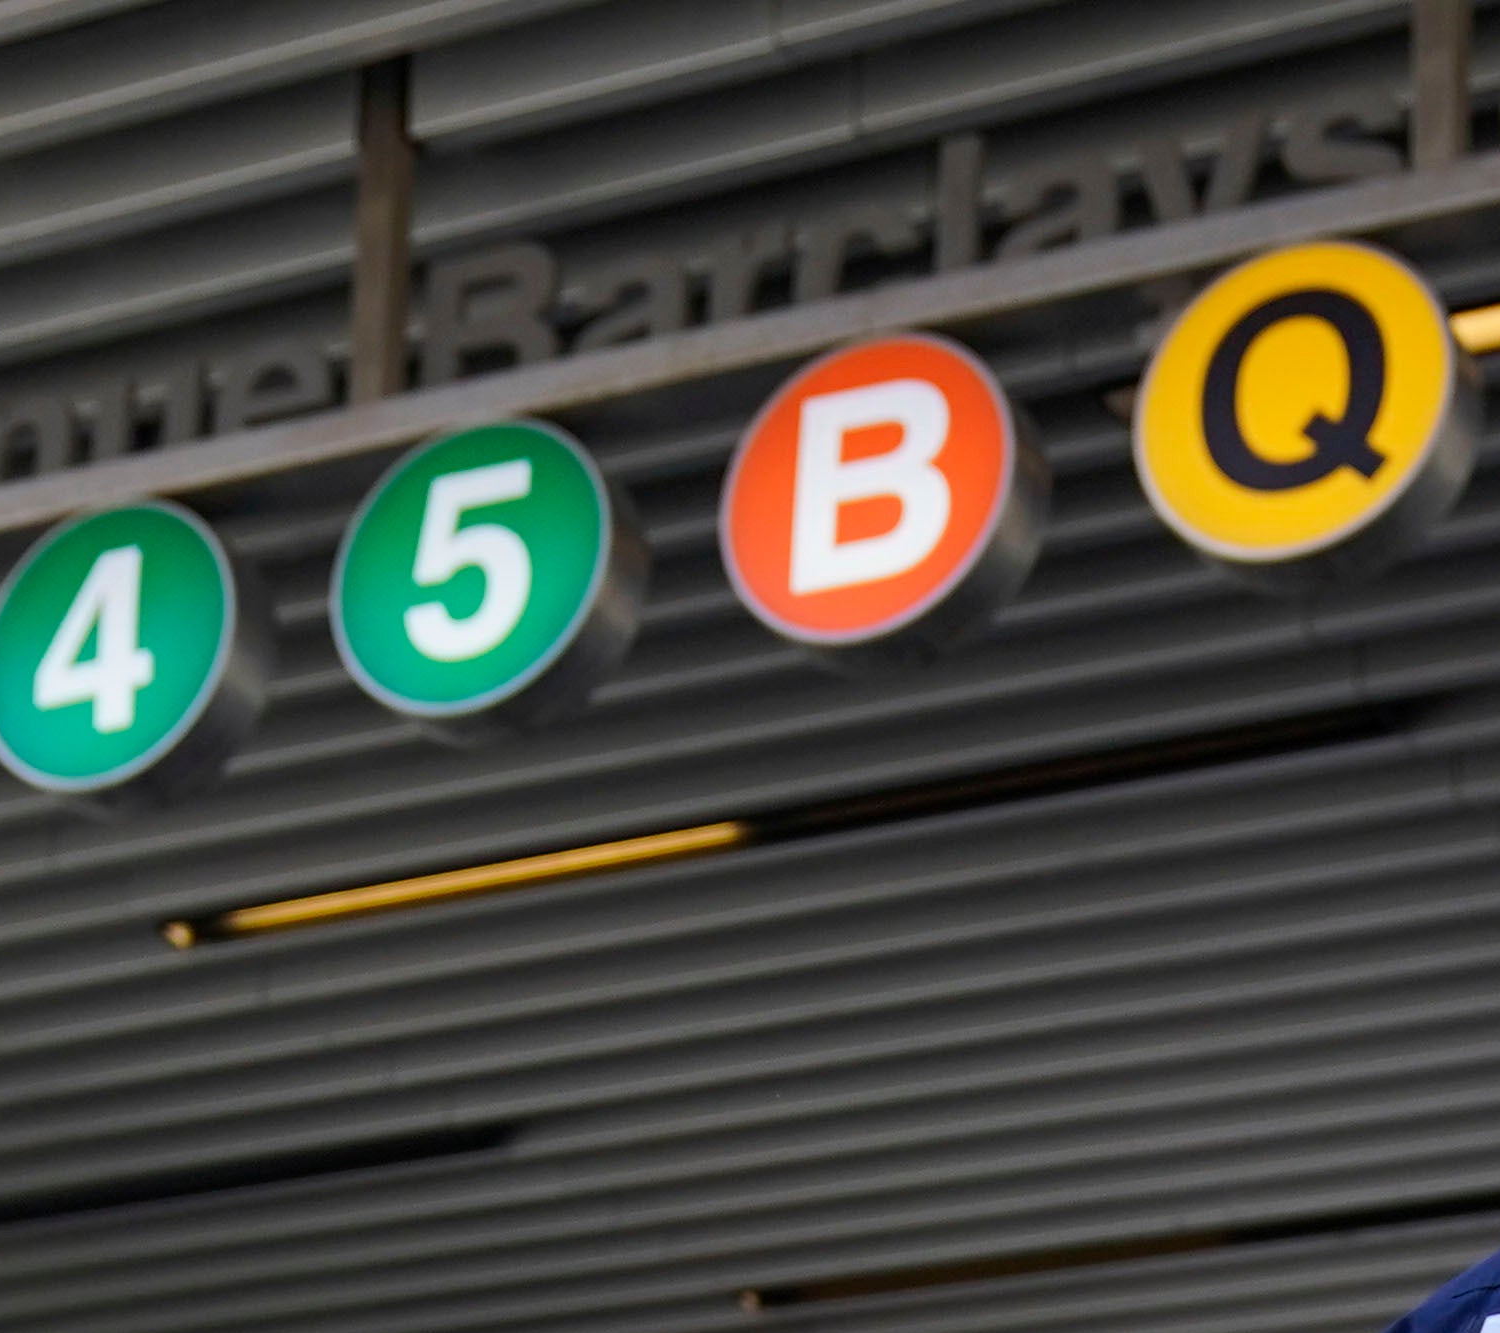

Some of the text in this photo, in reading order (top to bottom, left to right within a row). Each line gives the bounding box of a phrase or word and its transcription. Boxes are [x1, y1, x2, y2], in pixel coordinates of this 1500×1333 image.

[420, 92, 1410, 392] Barclays
[33, 545, 154, 733] 4
[403, 459, 532, 663] 5
[788, 378, 953, 597] B
[1201, 287, 1388, 492] Q
